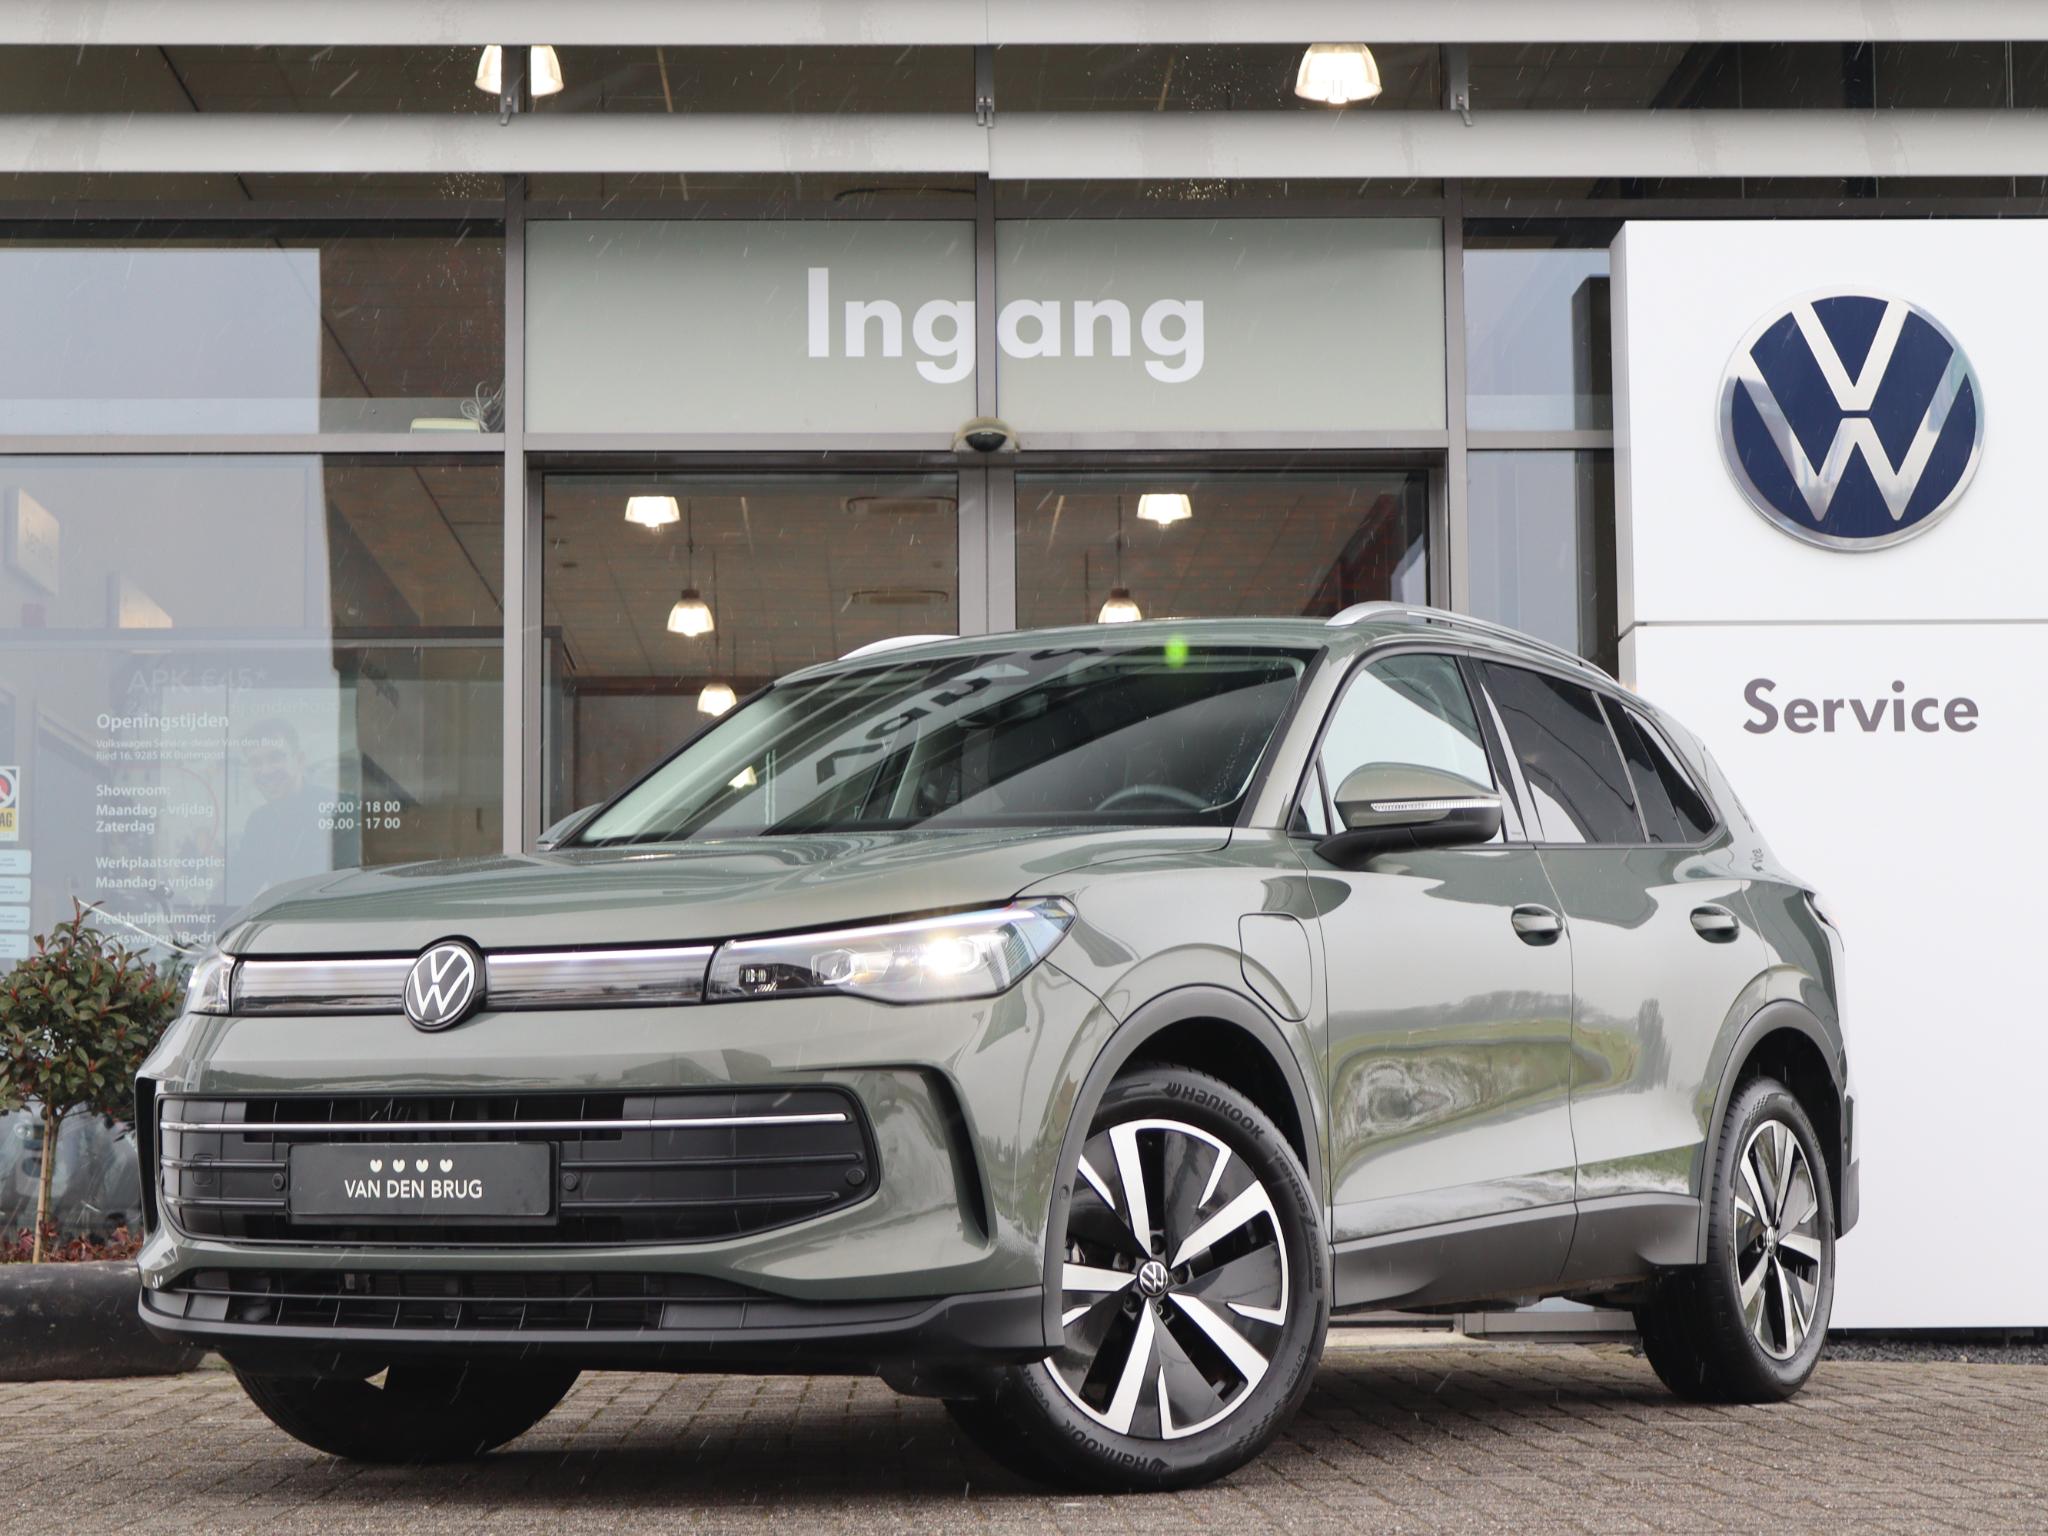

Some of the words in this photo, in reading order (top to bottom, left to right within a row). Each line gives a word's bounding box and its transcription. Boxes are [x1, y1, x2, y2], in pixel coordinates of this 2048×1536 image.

[808, 267, 1205, 384] Ingang
[1743, 678, 1979, 734] Service
[96, 712, 229, 731] Openingstijden
[96, 804, 157, 818] Maandag
[168, 803, 214, 818] vrijdag
[318, 801, 354, 813] 09.00
[96, 820, 155, 835] Zaterdag
[318, 818, 354, 830] 09.00
[95, 856, 225, 871] Werkplaatsreceptie:
[96, 876, 157, 891] Maandag
[168, 876, 214, 890] vrijdag
[344, 1179, 381, 1199] VAN
[387, 1179, 424, 1199] DEN
[431, 1179, 483, 1199] BRUG
